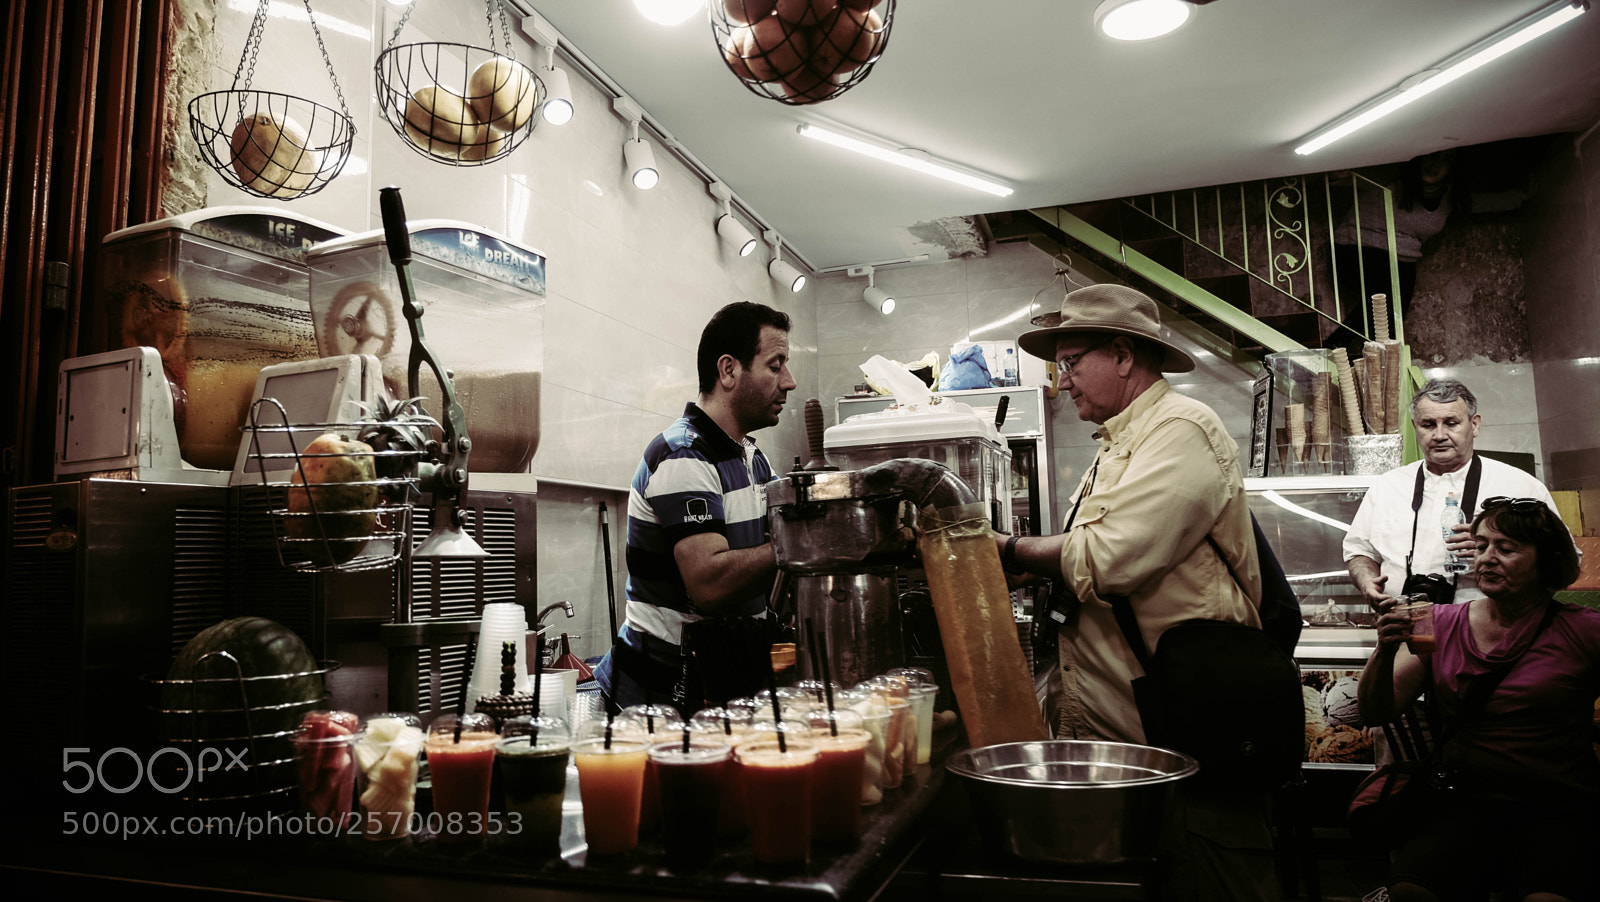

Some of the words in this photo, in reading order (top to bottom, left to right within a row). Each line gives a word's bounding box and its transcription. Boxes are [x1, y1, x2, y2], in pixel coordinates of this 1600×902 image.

[268, 220, 296, 238] ICE
[458, 231, 480, 247] ICE
[484, 247, 529, 268] DREAM
